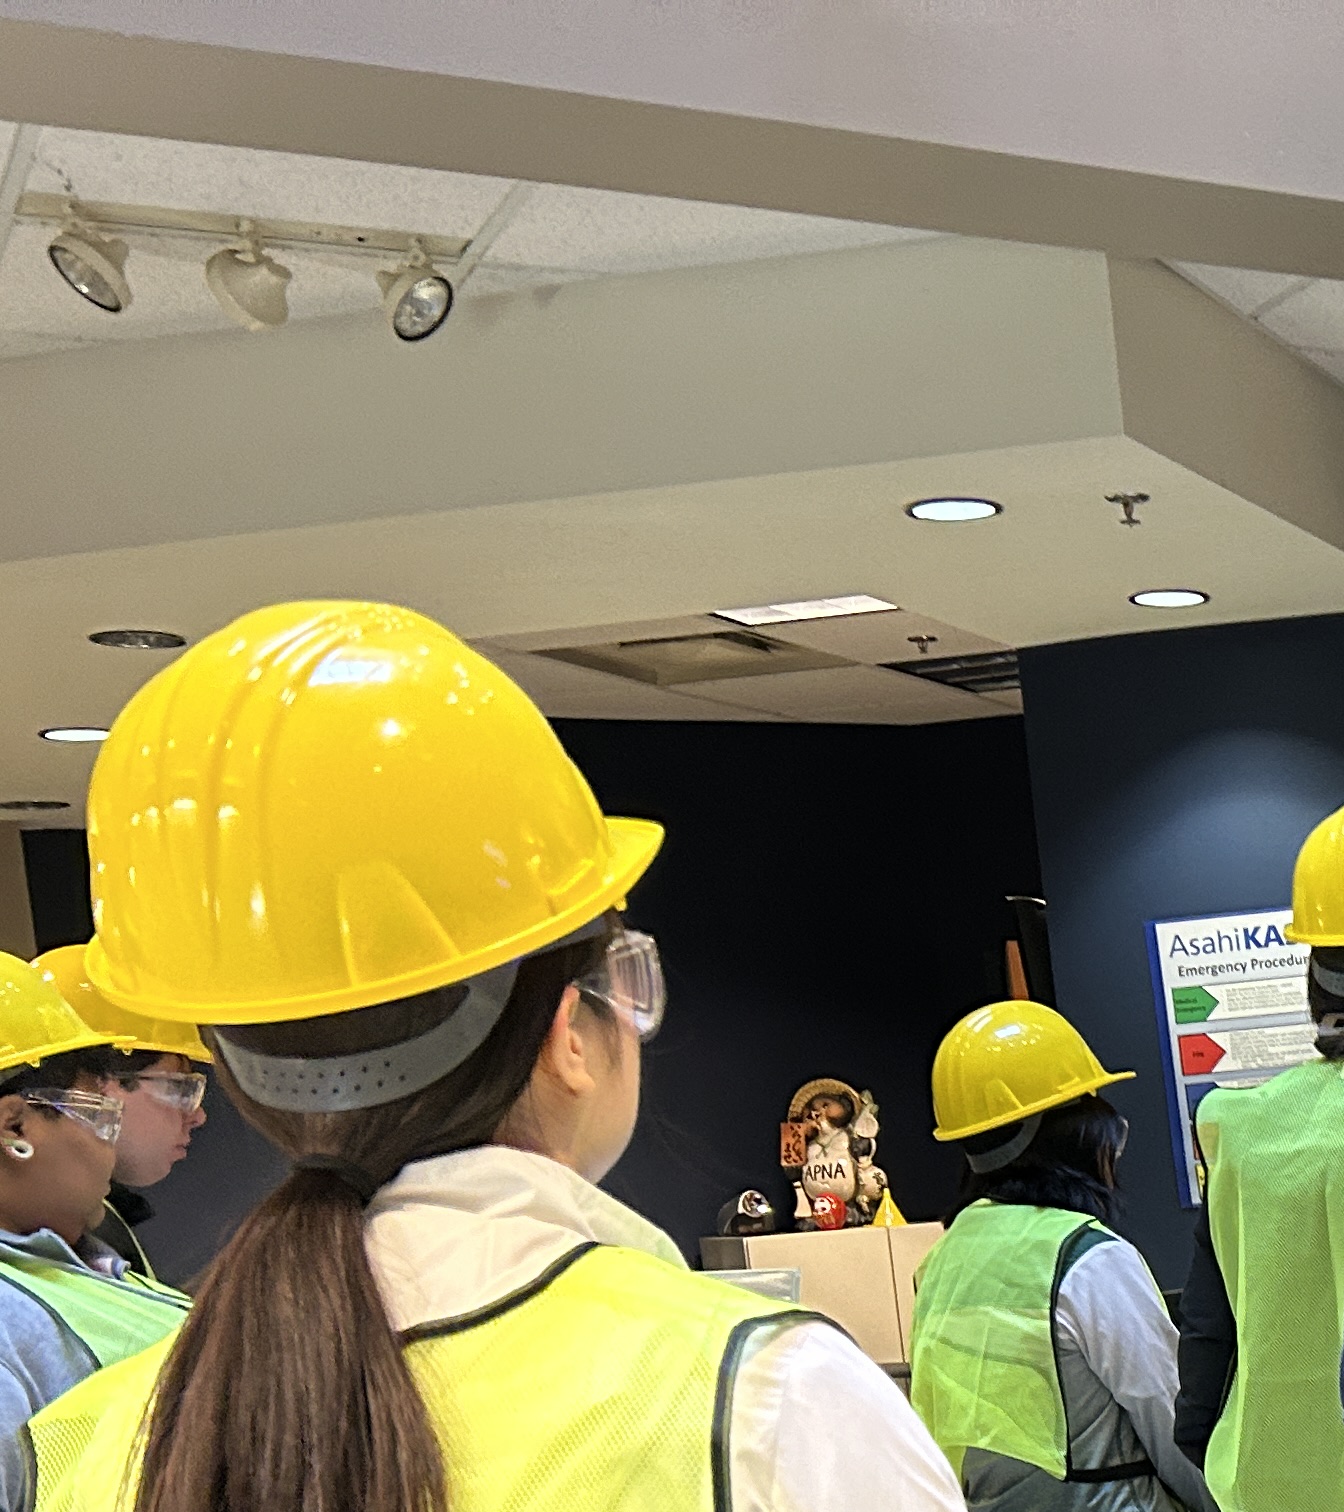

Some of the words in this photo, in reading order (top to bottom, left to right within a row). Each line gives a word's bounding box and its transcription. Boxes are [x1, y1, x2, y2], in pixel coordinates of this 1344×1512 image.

[1169, 924, 1297, 958] AsahiKA
[1178, 961, 1247, 977] Emergency
[805, 1163, 846, 1181] APNA
